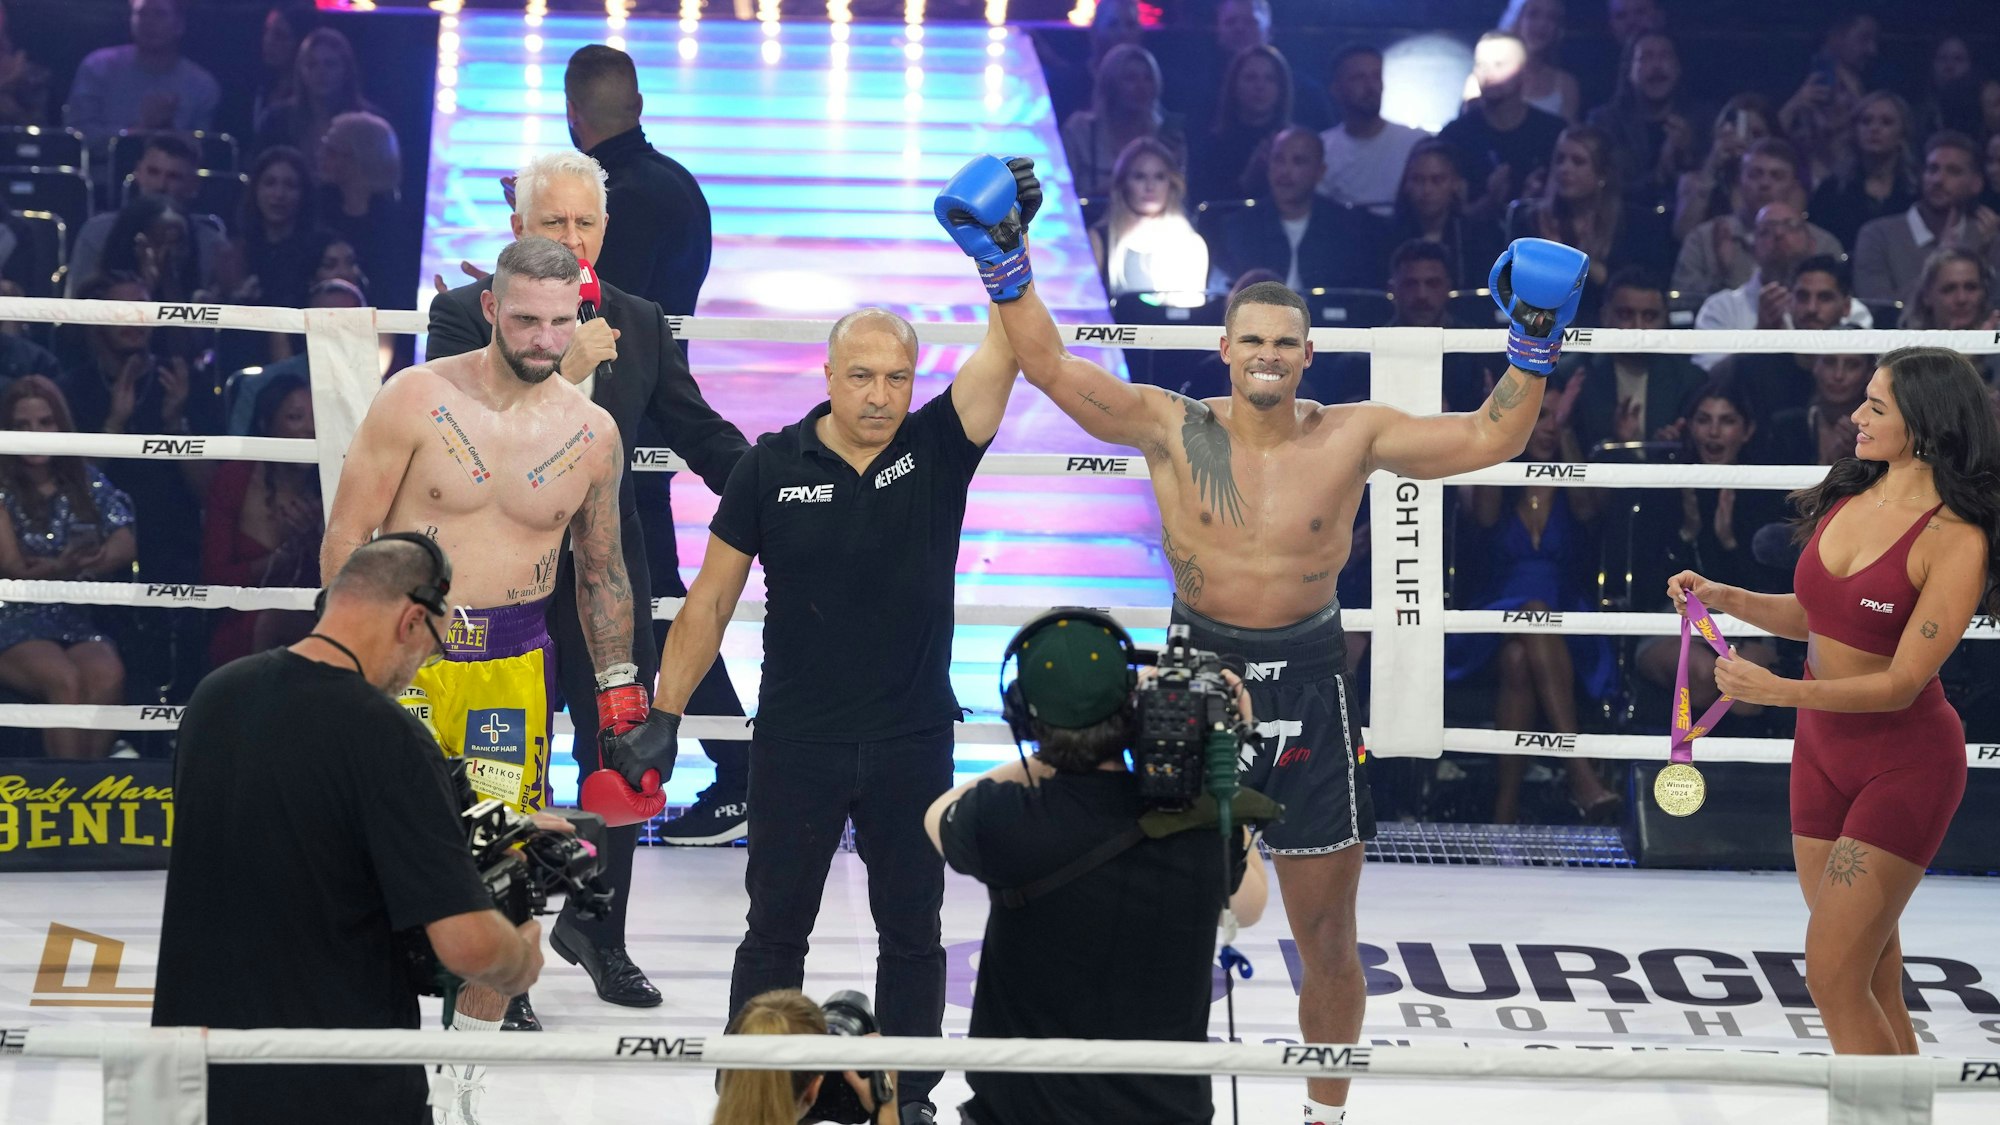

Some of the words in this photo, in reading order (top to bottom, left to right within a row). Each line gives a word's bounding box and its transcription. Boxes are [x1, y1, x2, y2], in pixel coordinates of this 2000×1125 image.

[157, 307, 221, 321] FAME
[1075, 328, 1137, 341] FAME
[1564, 329, 1593, 342] ME
[142, 440, 206, 454] FAME
[444, 411, 471, 446] Kartcenter
[468, 446, 487, 473] Cologne
[533, 447, 566, 475] Kartcenter
[564, 429, 585, 450] Cologne
[632, 450, 670, 464] ME
[1067, 457, 1129, 471] FAME
[1525, 464, 1588, 477] FAME
[777, 484, 834, 502] FAME
[1396, 482, 1420, 548] GHT
[147, 585, 208, 597] FAME
[506, 588, 519, 600] Mr
[520, 585, 537, 598] and
[1396, 559, 1420, 626] LIFE
[1860, 598, 1895, 611] FAME
[1502, 611, 1564, 623] FAME
[446, 629, 484, 647] NLEE
[140, 707, 186, 720] FAM
[1678, 687, 1690, 731] FAME
[471, 744, 490, 752] BANK
[500, 745, 518, 753] HAIR
[1515, 734, 1577, 748] FAME
[488, 766, 521, 781] RIKOS
[0, 774, 77, 805] Rocky
[82, 775, 173, 801] Marc
[1666, 781, 1692, 789] Winner
[715, 802, 747, 818] PRA
[0, 802, 175, 852] BENL
[1398, 1003, 2000, 1043] ROTHER
[616, 1037, 706, 1056] FAME
[1282, 1046, 1373, 1065] FAME
[1960, 1062, 2000, 1082] FA
